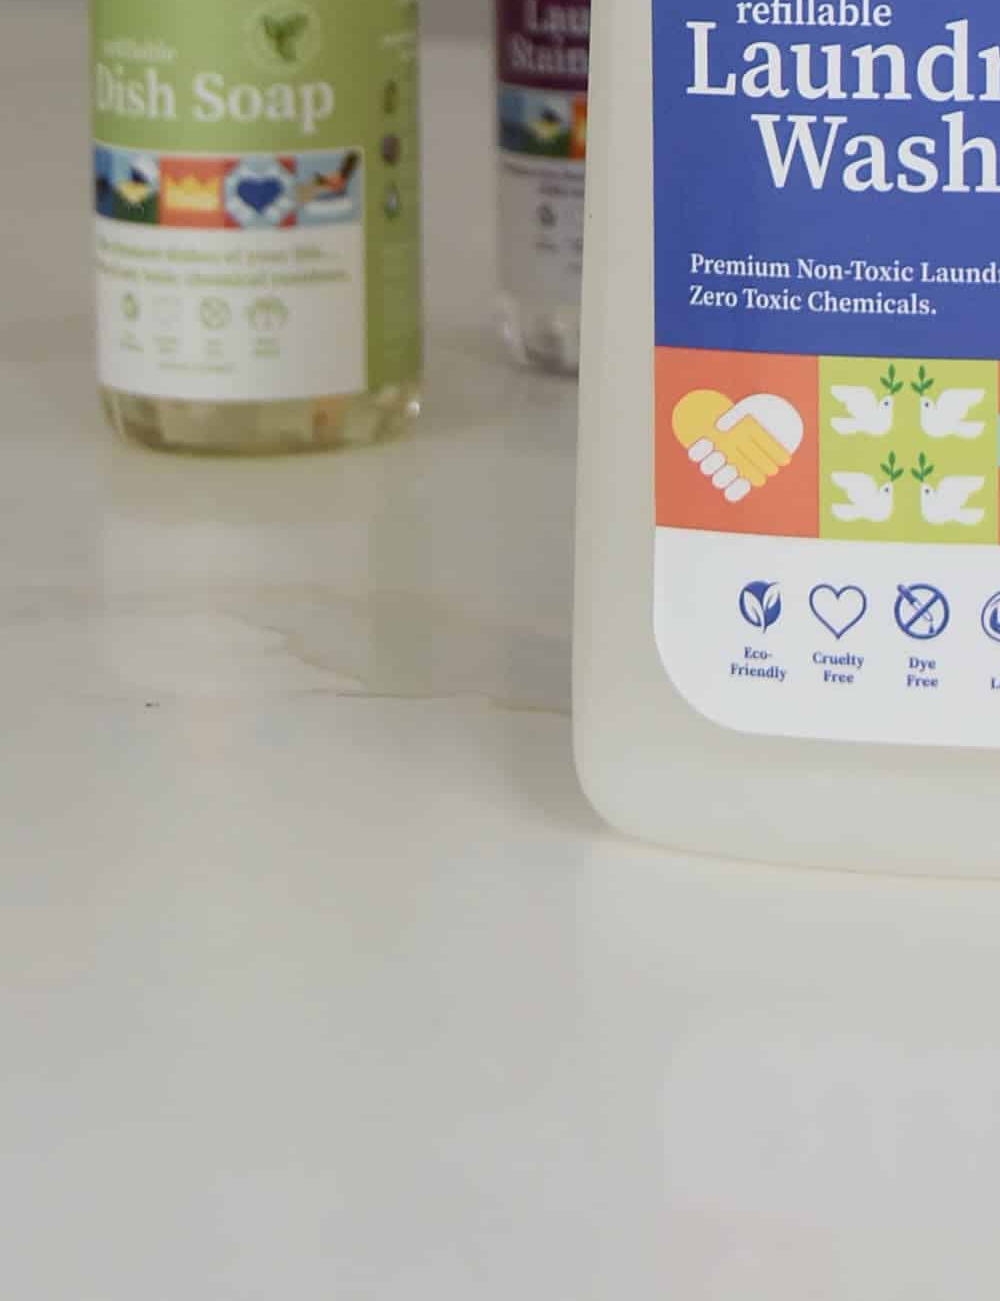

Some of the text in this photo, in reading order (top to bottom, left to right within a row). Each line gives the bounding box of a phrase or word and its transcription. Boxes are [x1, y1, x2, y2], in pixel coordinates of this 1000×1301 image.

[192, 72, 334, 133] Soap
[690, 254, 790, 279] Premium
[797, 258, 914, 283] Non-Toxic
[689, 285, 937, 316] Zero Toxic Chemicals.
[743, 647, 773, 661] Eco-
[812, 652, 864, 669] Cruelty
[729, 662, 787, 681] Friendly
[908, 657, 936, 671] Dye
[823, 670, 854, 684] Free
[906, 674, 939, 688] Free
